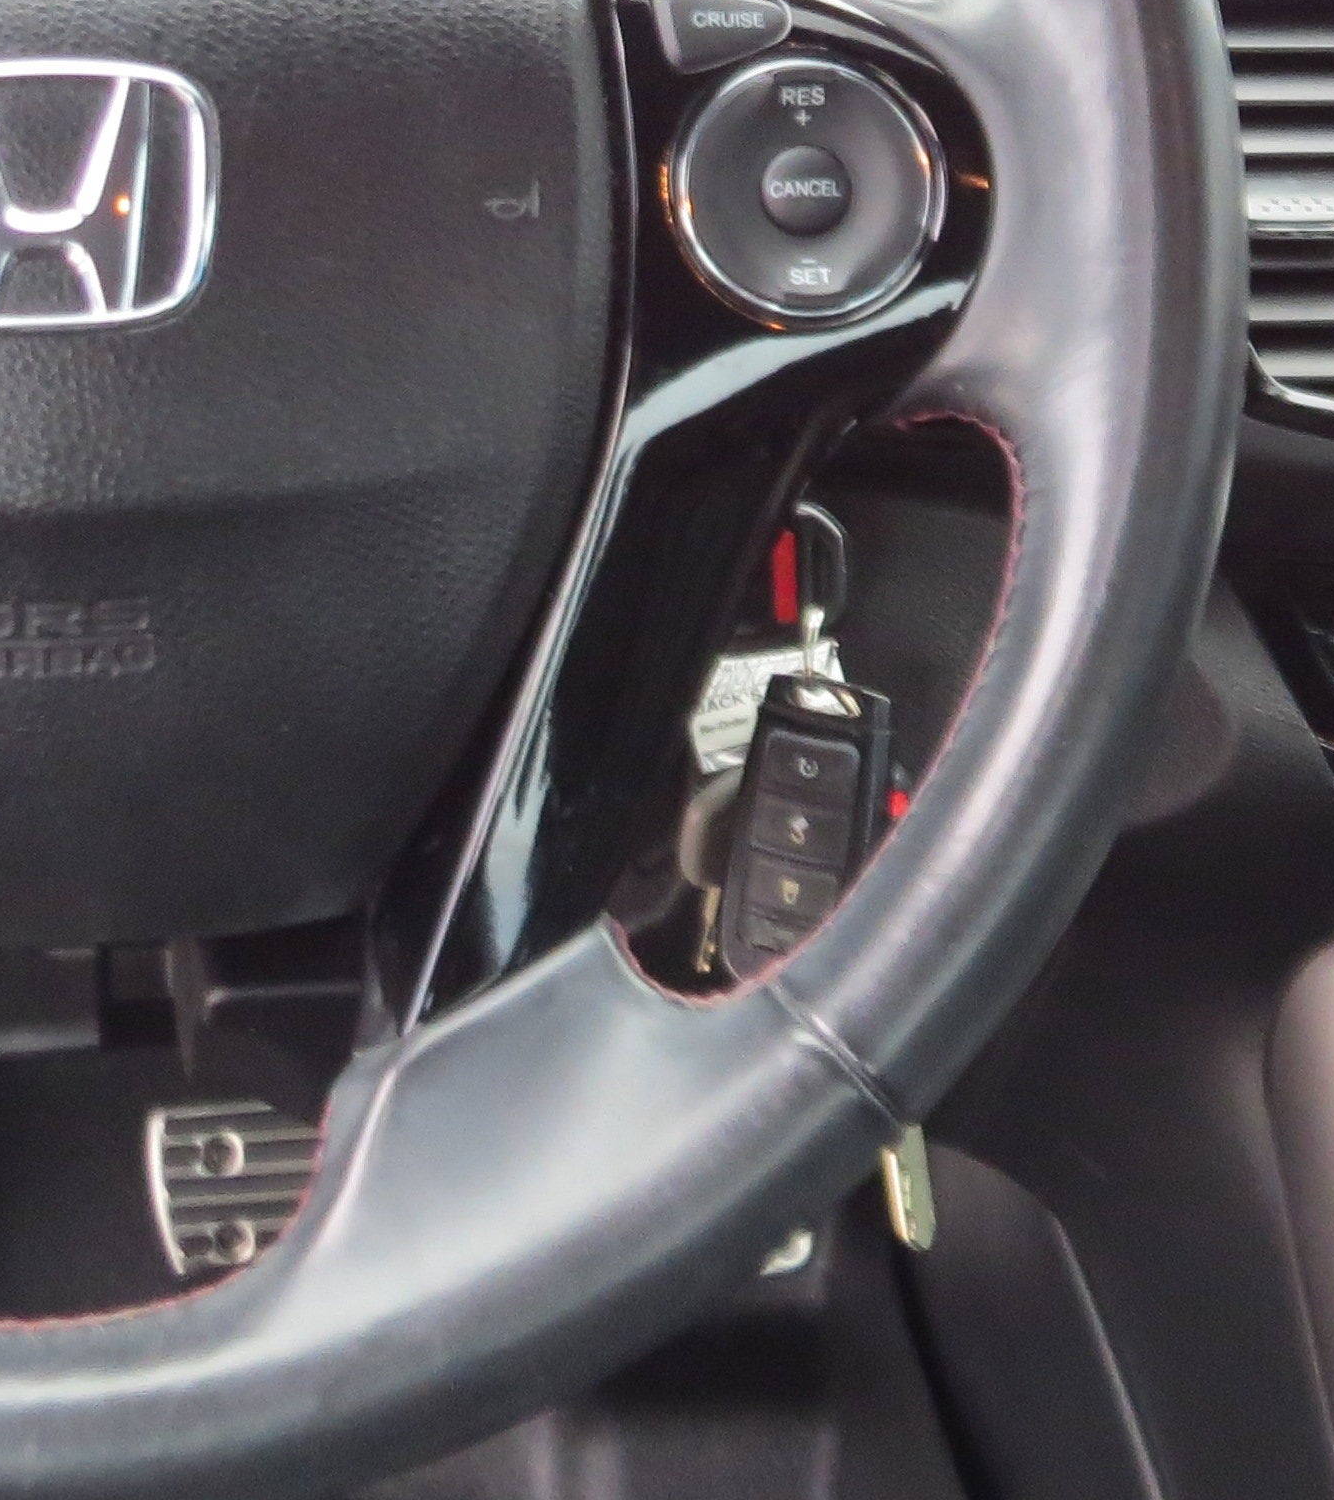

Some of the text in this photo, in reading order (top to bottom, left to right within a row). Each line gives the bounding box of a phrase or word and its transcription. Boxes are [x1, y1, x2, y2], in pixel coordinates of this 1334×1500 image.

[690, 10, 765, 29] CRUISE
[778, 84, 827, 108] RES
[768, 180, 843, 200] CANCEL
[788, 266, 833, 287] SET
